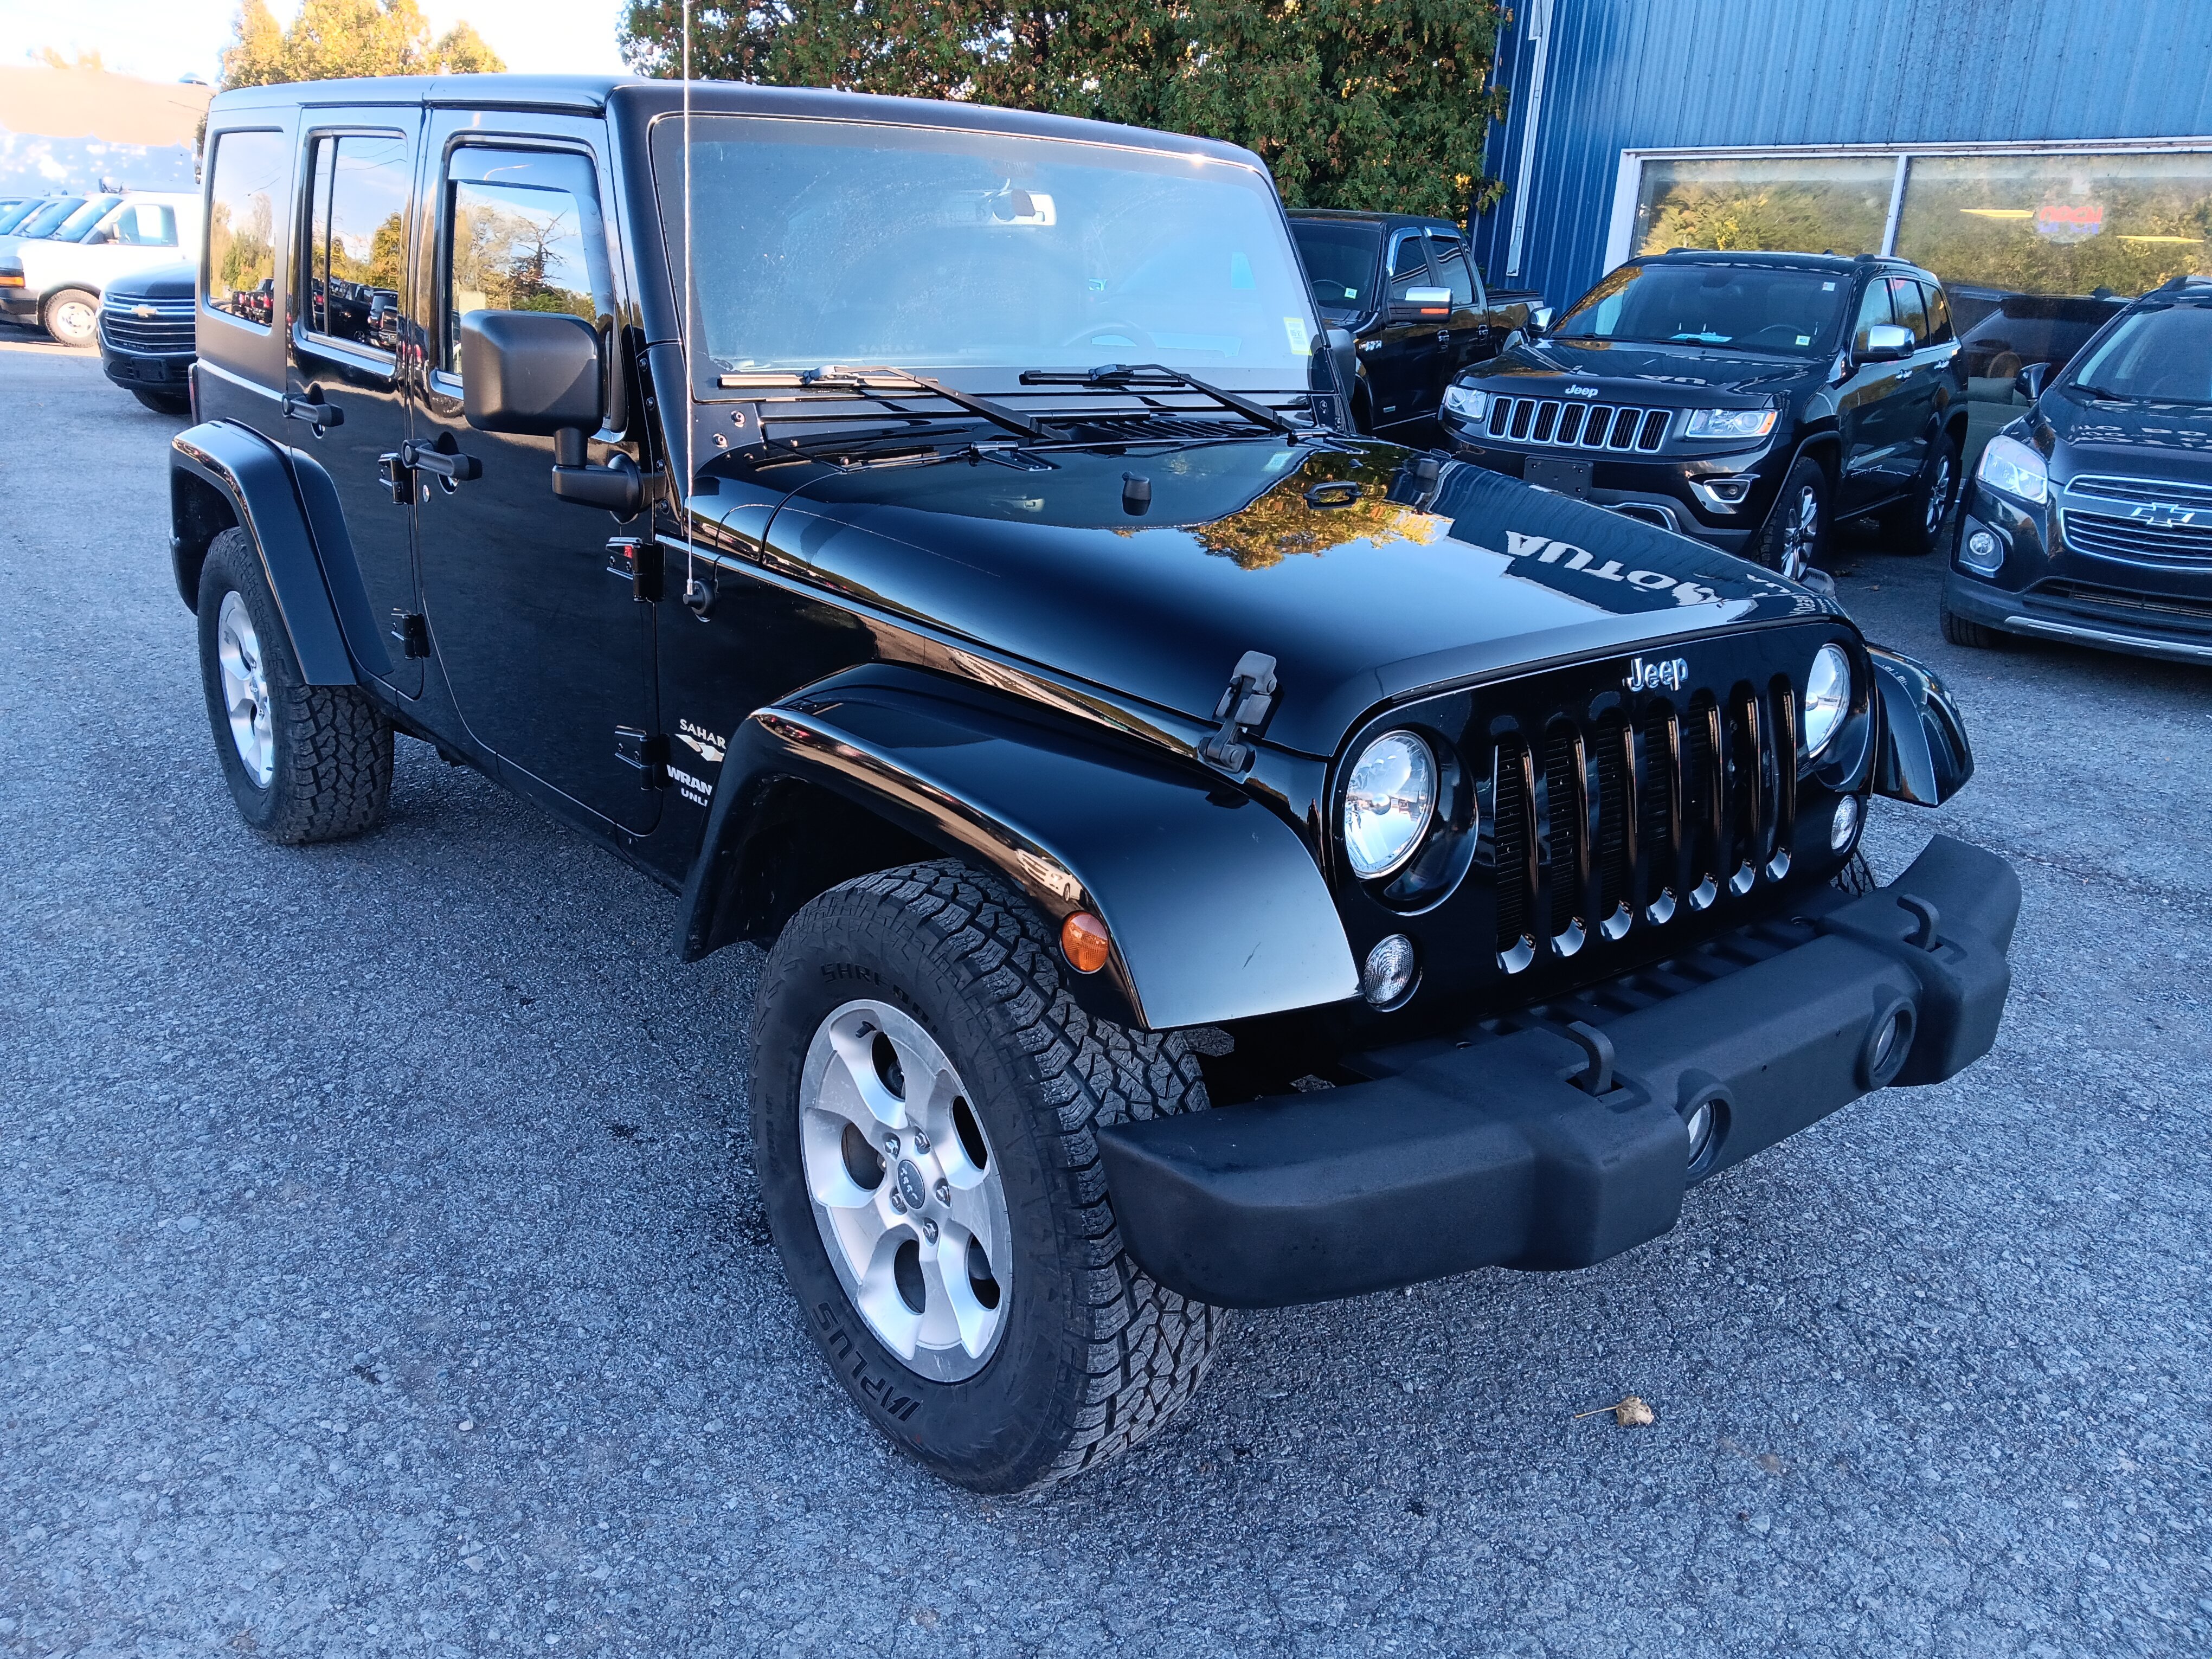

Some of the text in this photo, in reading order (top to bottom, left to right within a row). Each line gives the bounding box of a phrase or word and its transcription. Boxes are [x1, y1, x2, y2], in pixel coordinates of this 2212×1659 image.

[1565, 384, 1598, 398] Jeep
[1626, 658, 1688, 692] Jeep
[680, 719, 726, 749] SAHAR
[666, 764, 712, 796] WRAN
[681, 788, 708, 807] UNLI
